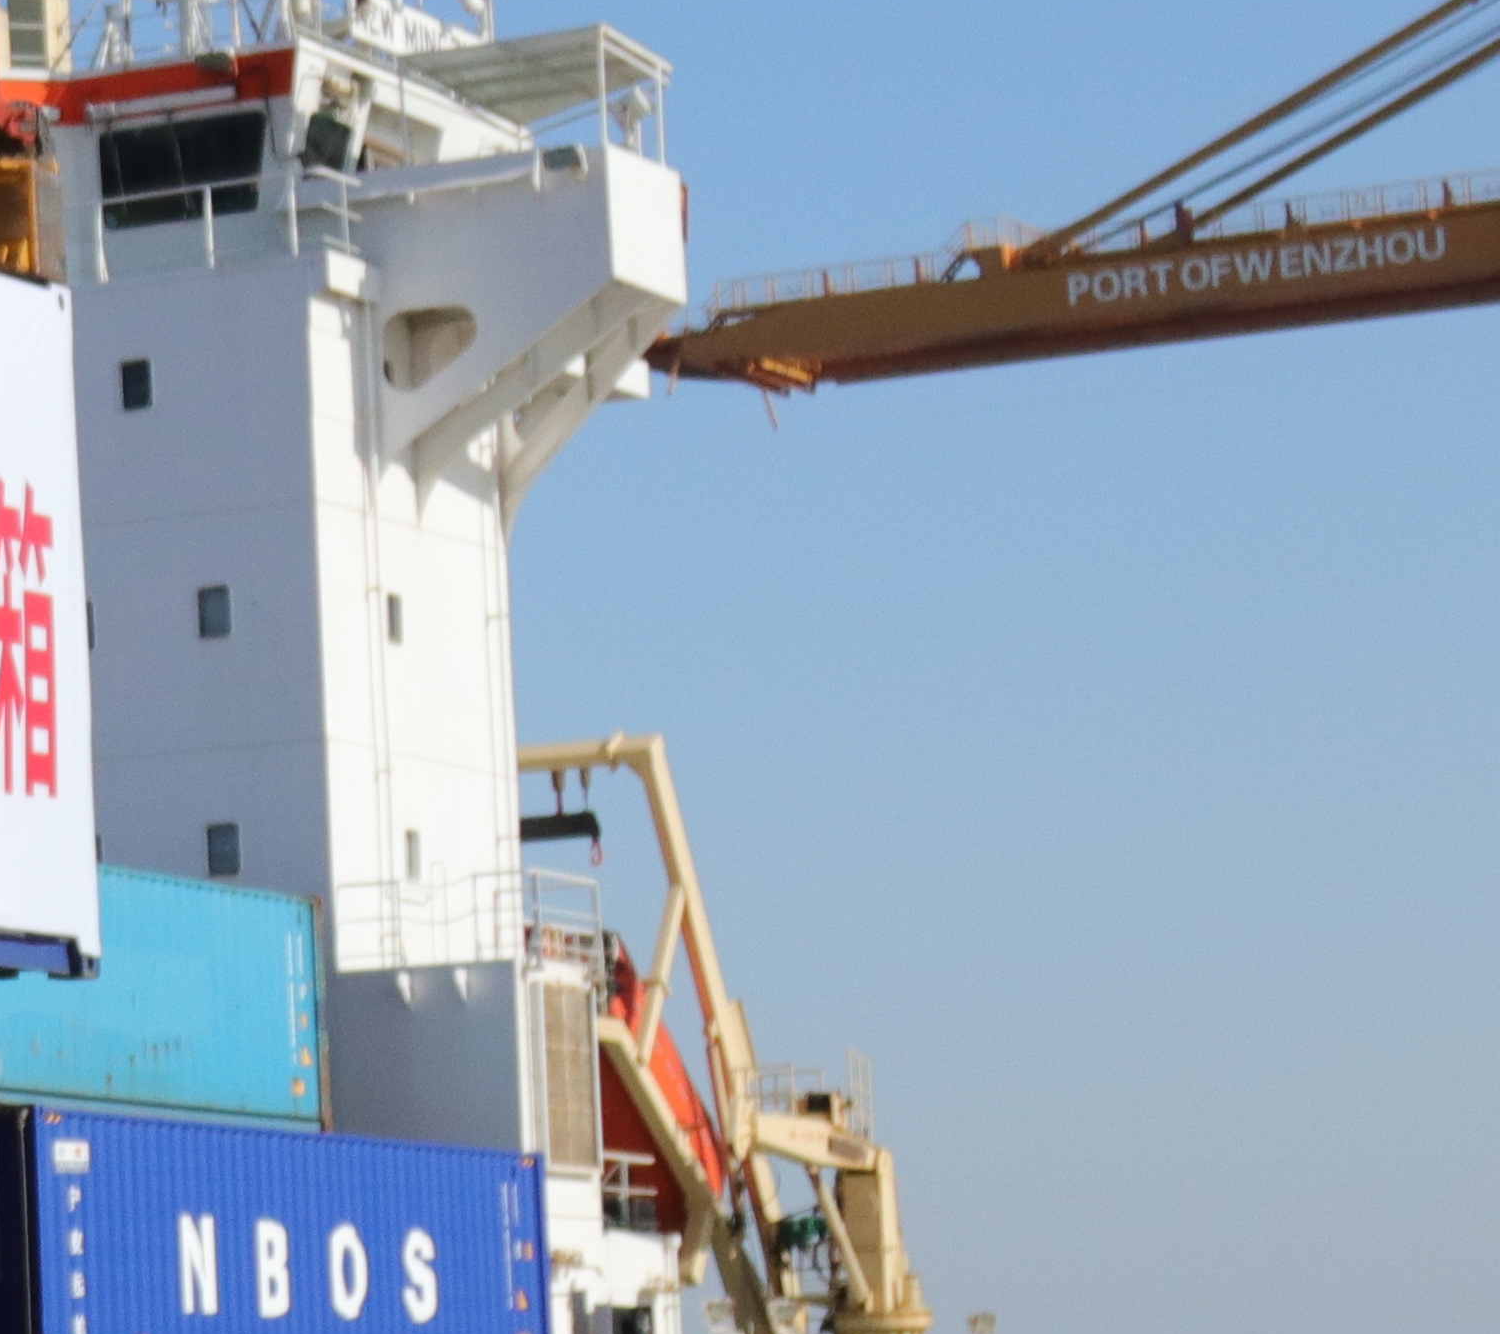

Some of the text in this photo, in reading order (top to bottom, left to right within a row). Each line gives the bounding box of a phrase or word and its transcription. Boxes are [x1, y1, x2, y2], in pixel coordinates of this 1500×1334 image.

[1066, 260, 1174, 308] PORT
[1234, 225, 1447, 286] WENZHOU
[177, 1210, 440, 1326] NBOS
